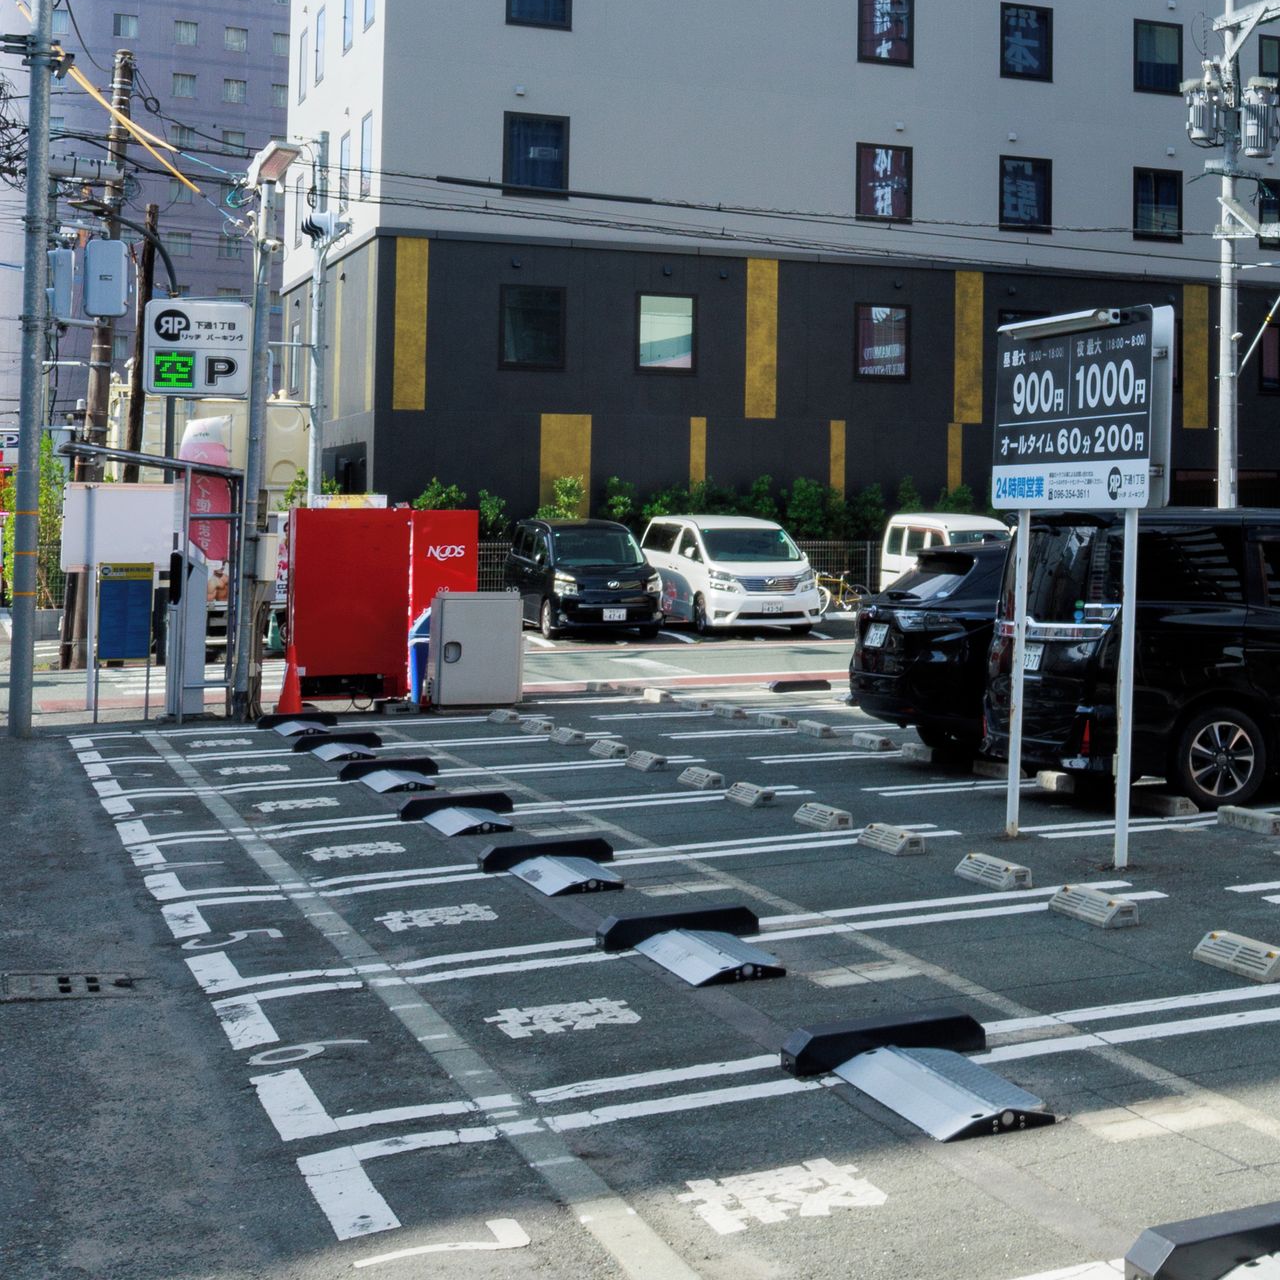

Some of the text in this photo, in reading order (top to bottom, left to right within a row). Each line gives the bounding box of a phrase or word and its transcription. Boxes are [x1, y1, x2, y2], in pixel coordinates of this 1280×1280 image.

[154, 351, 194, 388] 空
[205, 356, 238, 386] P
[1075, 358, 1147, 409] 1000円
[1013, 369, 1064, 416] 900円
[995, 476, 1045, 499] 24時間営業
